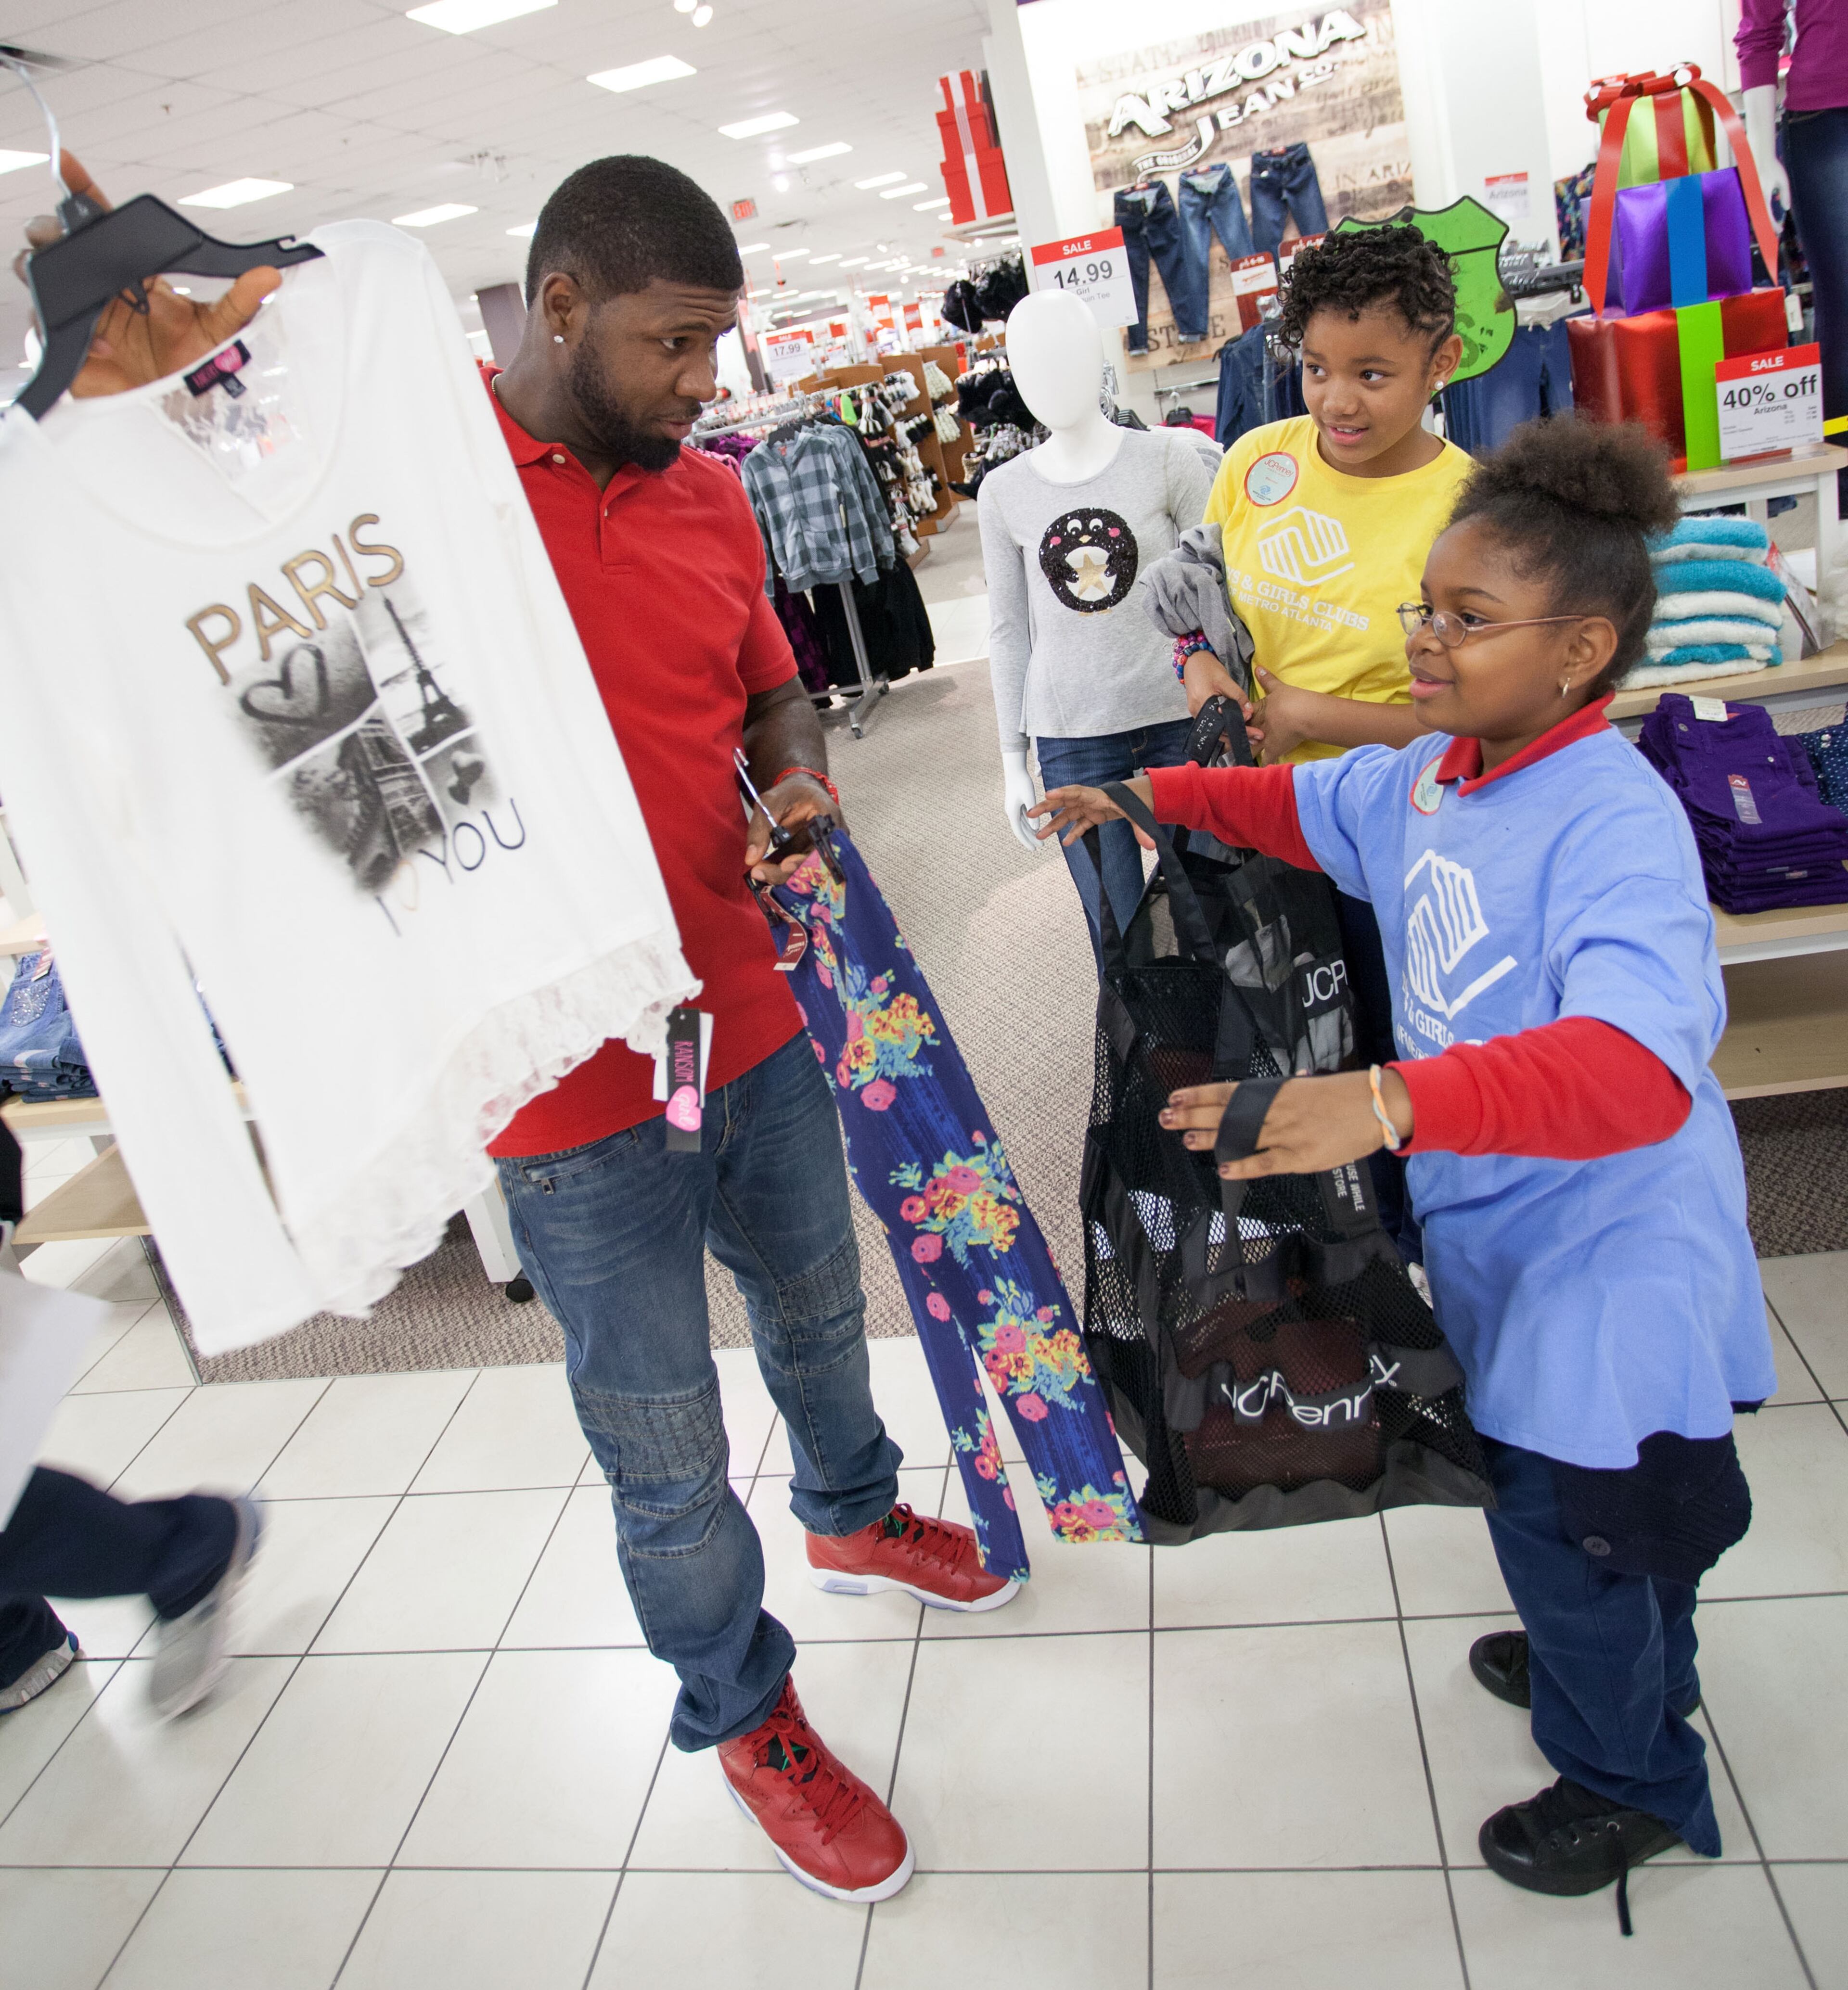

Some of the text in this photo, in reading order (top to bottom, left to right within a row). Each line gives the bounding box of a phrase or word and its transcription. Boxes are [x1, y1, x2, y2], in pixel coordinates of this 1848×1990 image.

[1107, 9, 1366, 137] ARIZONA
[1195, 77, 1295, 150] JEAN
[1062, 240, 1092, 255] SALE
[1054, 260, 1113, 289] 14.99
[774, 343, 801, 356] 17.99
[1751, 356, 1784, 371] SALE
[1723, 374, 1817, 408] 40% off
[1754, 404, 1787, 415] Arizona
[185, 514, 405, 686] PARIS
[1238, 591, 1279, 612] METRO
[1281, 606, 1333, 632] ATLANTA
[1241, 574, 1252, 592] &
[1257, 580, 1310, 611] GIRLS
[1313, 601, 1370, 631] CLUBS
[417, 797, 526, 884] YOU
[1302, 959, 1348, 1008] JCP
[675, 1041, 694, 1082] RANSOM
[1332, 1168, 1348, 1198] STORE
[1346, 1164, 1365, 1212] USE WHILE
